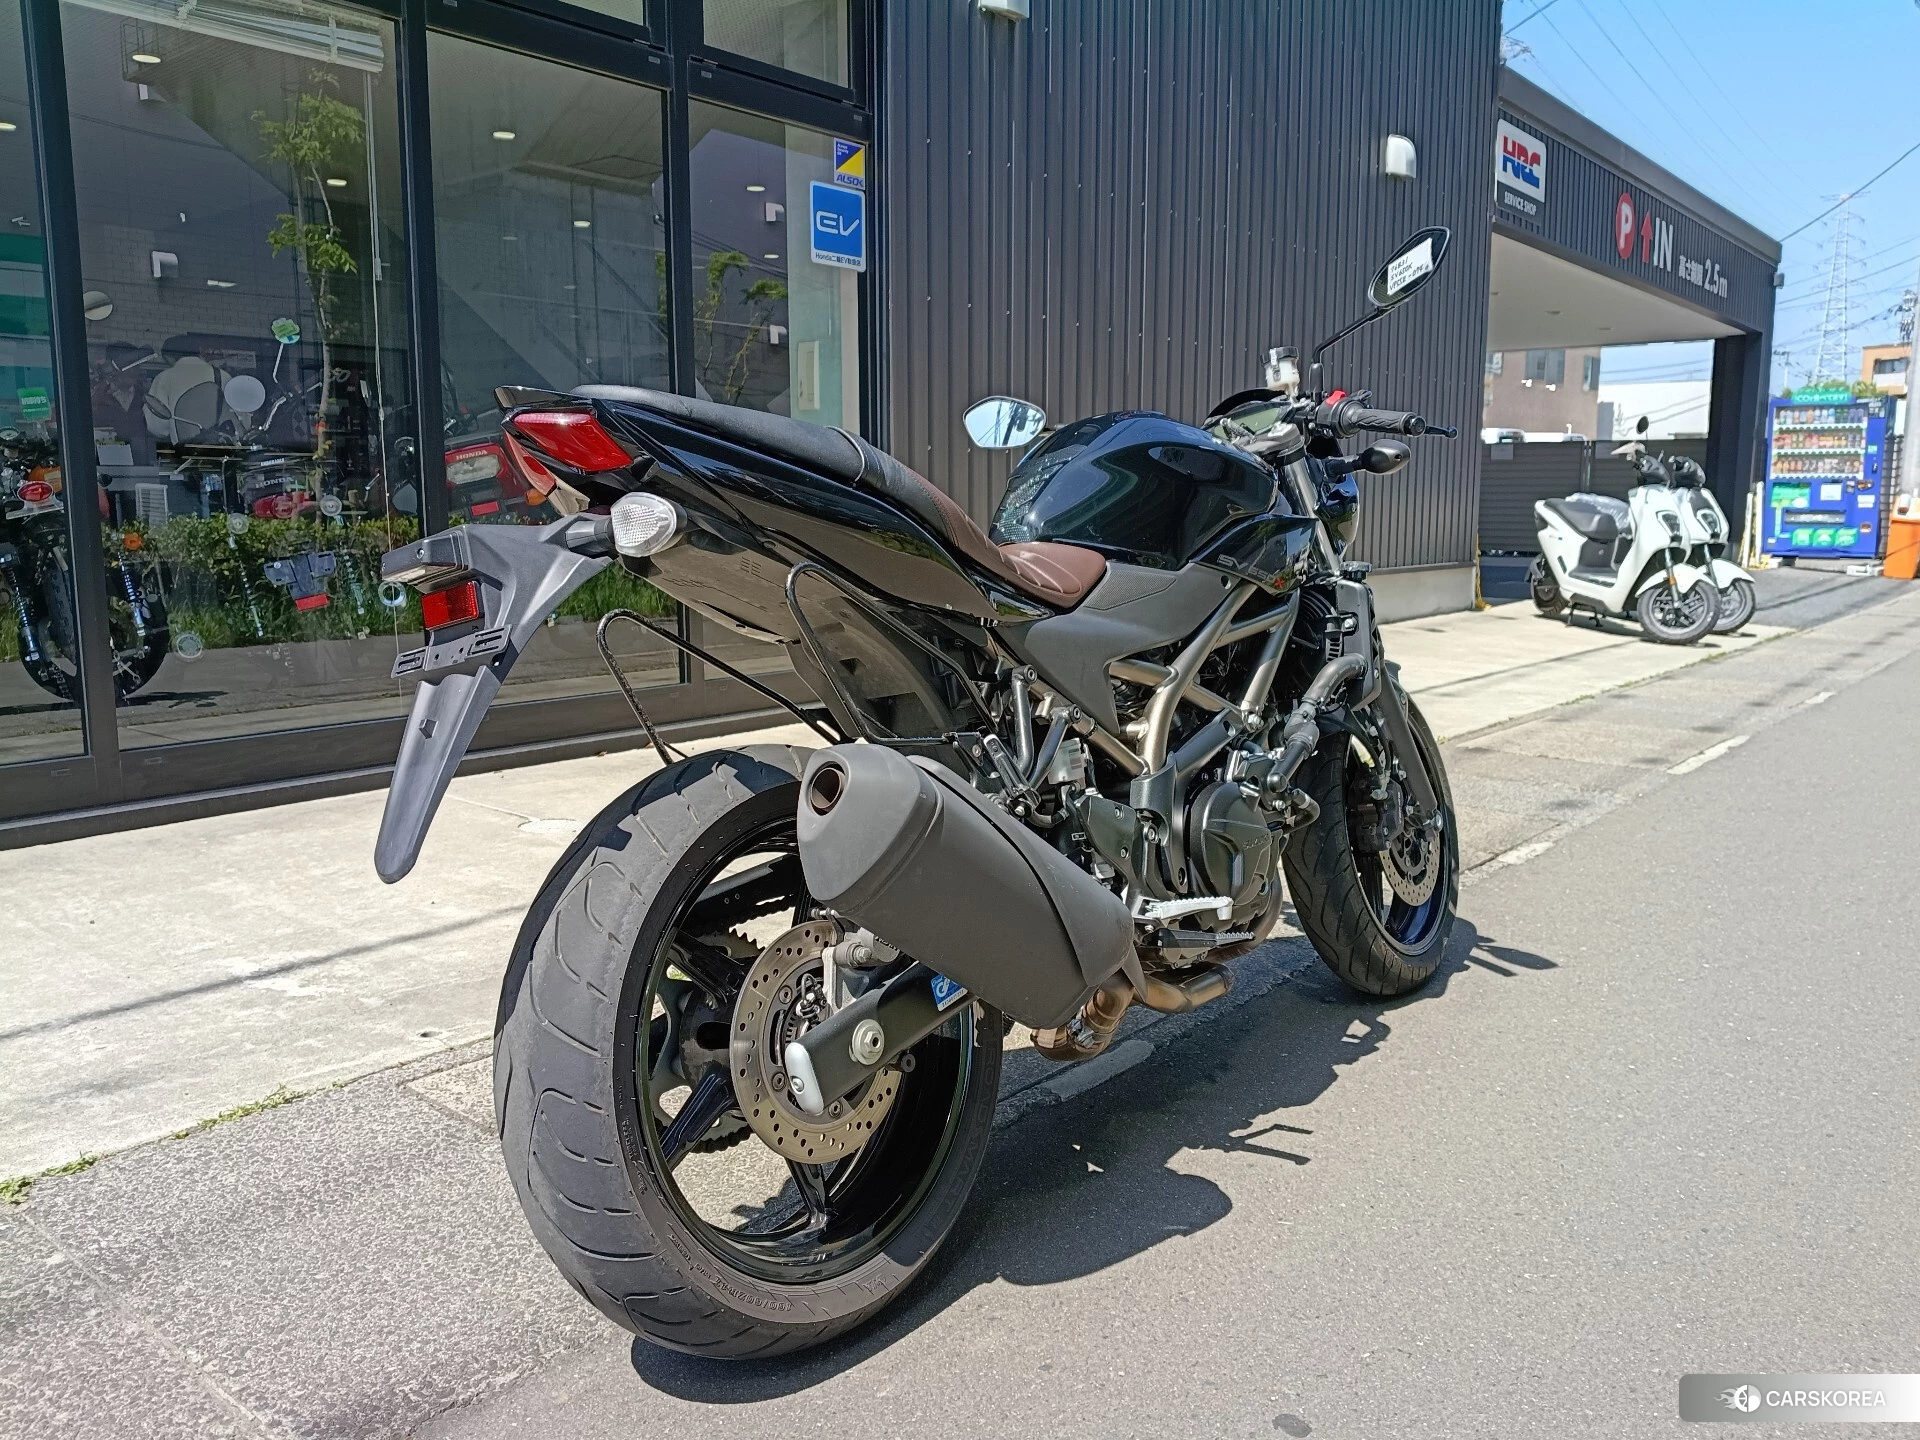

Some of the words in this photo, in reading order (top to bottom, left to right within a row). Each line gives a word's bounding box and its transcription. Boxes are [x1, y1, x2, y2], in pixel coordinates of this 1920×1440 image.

[1502, 135, 1541, 190] HRC
[836, 174, 864, 188] ALSOK
[1504, 190, 1524, 211] SERVICE
[1523, 200, 1537, 216] SHOP
[815, 210, 860, 237] EV
[1619, 201, 1634, 250] P
[1653, 216, 1674, 272] IN
[1704, 258, 1728, 299] 2.5m
[456, 449, 488, 461] HONDA
[255, 476, 294, 489] HONDA
[1217, 553, 1249, 570] SV
